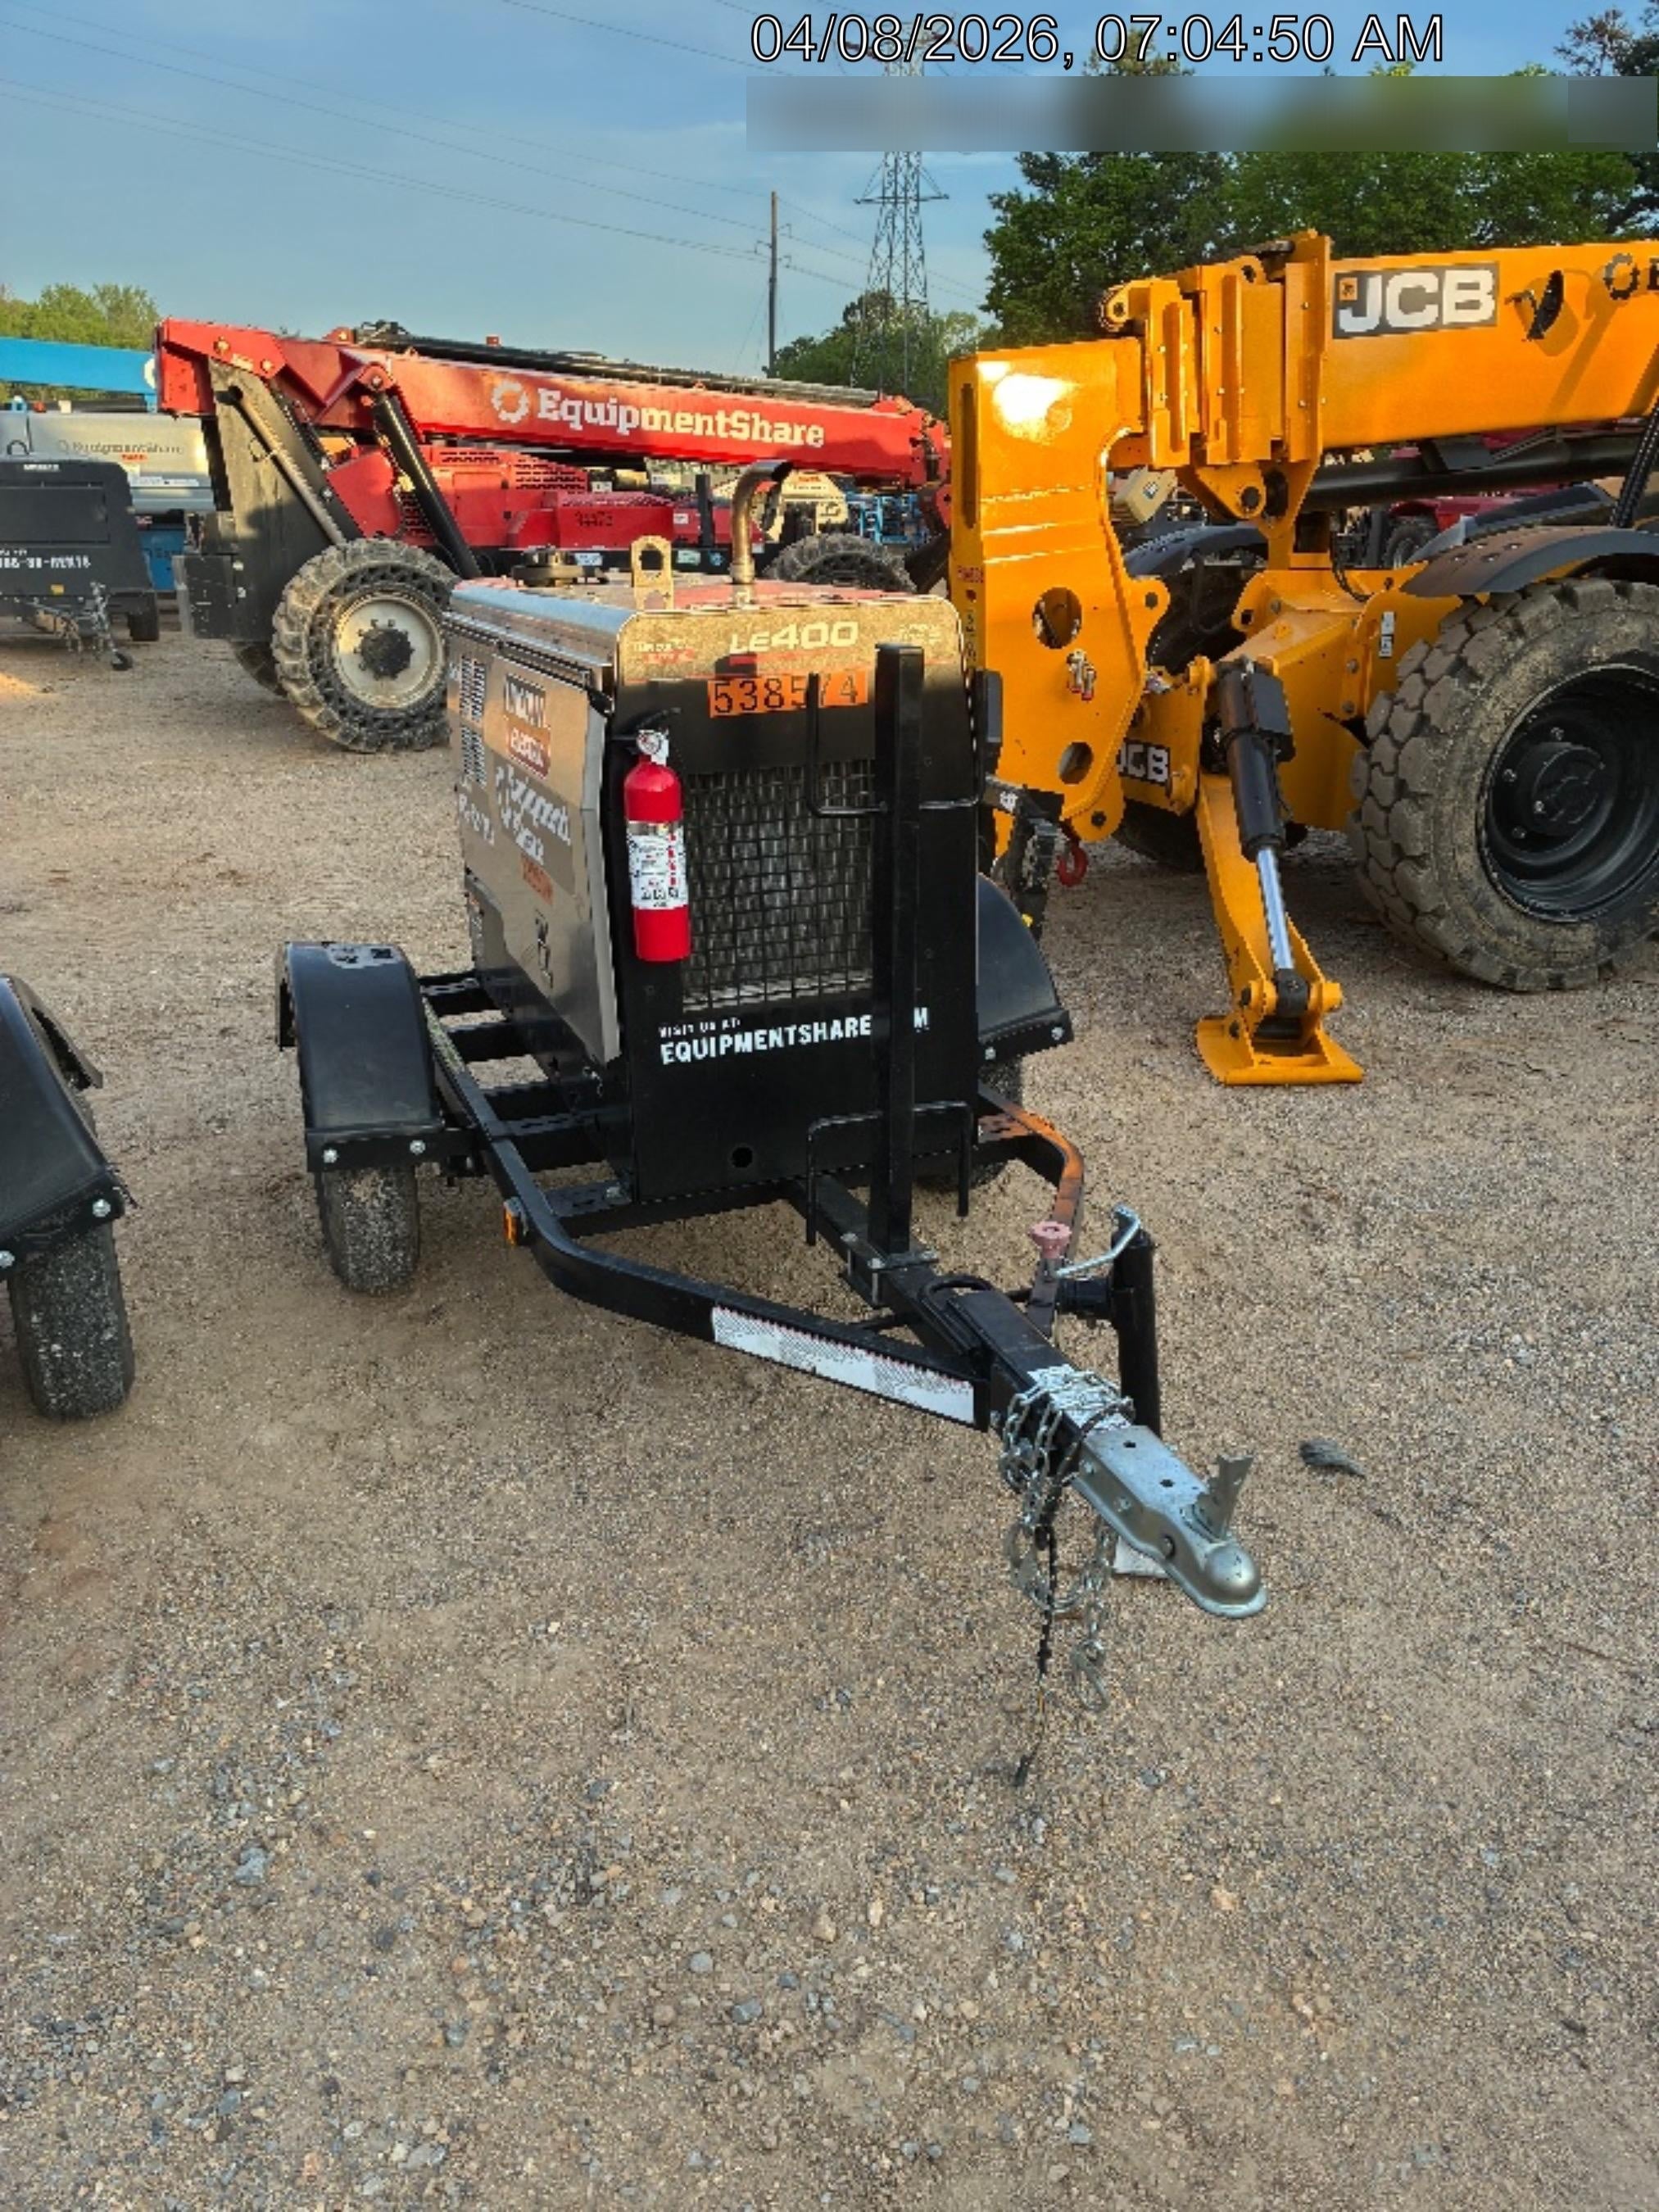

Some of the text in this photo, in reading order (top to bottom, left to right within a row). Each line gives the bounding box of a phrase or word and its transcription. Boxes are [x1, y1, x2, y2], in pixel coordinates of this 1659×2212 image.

[1339, 270, 1494, 333] JCB
[537, 388, 825, 447] EquipmentShare
[729, 621, 859, 654] LE400
